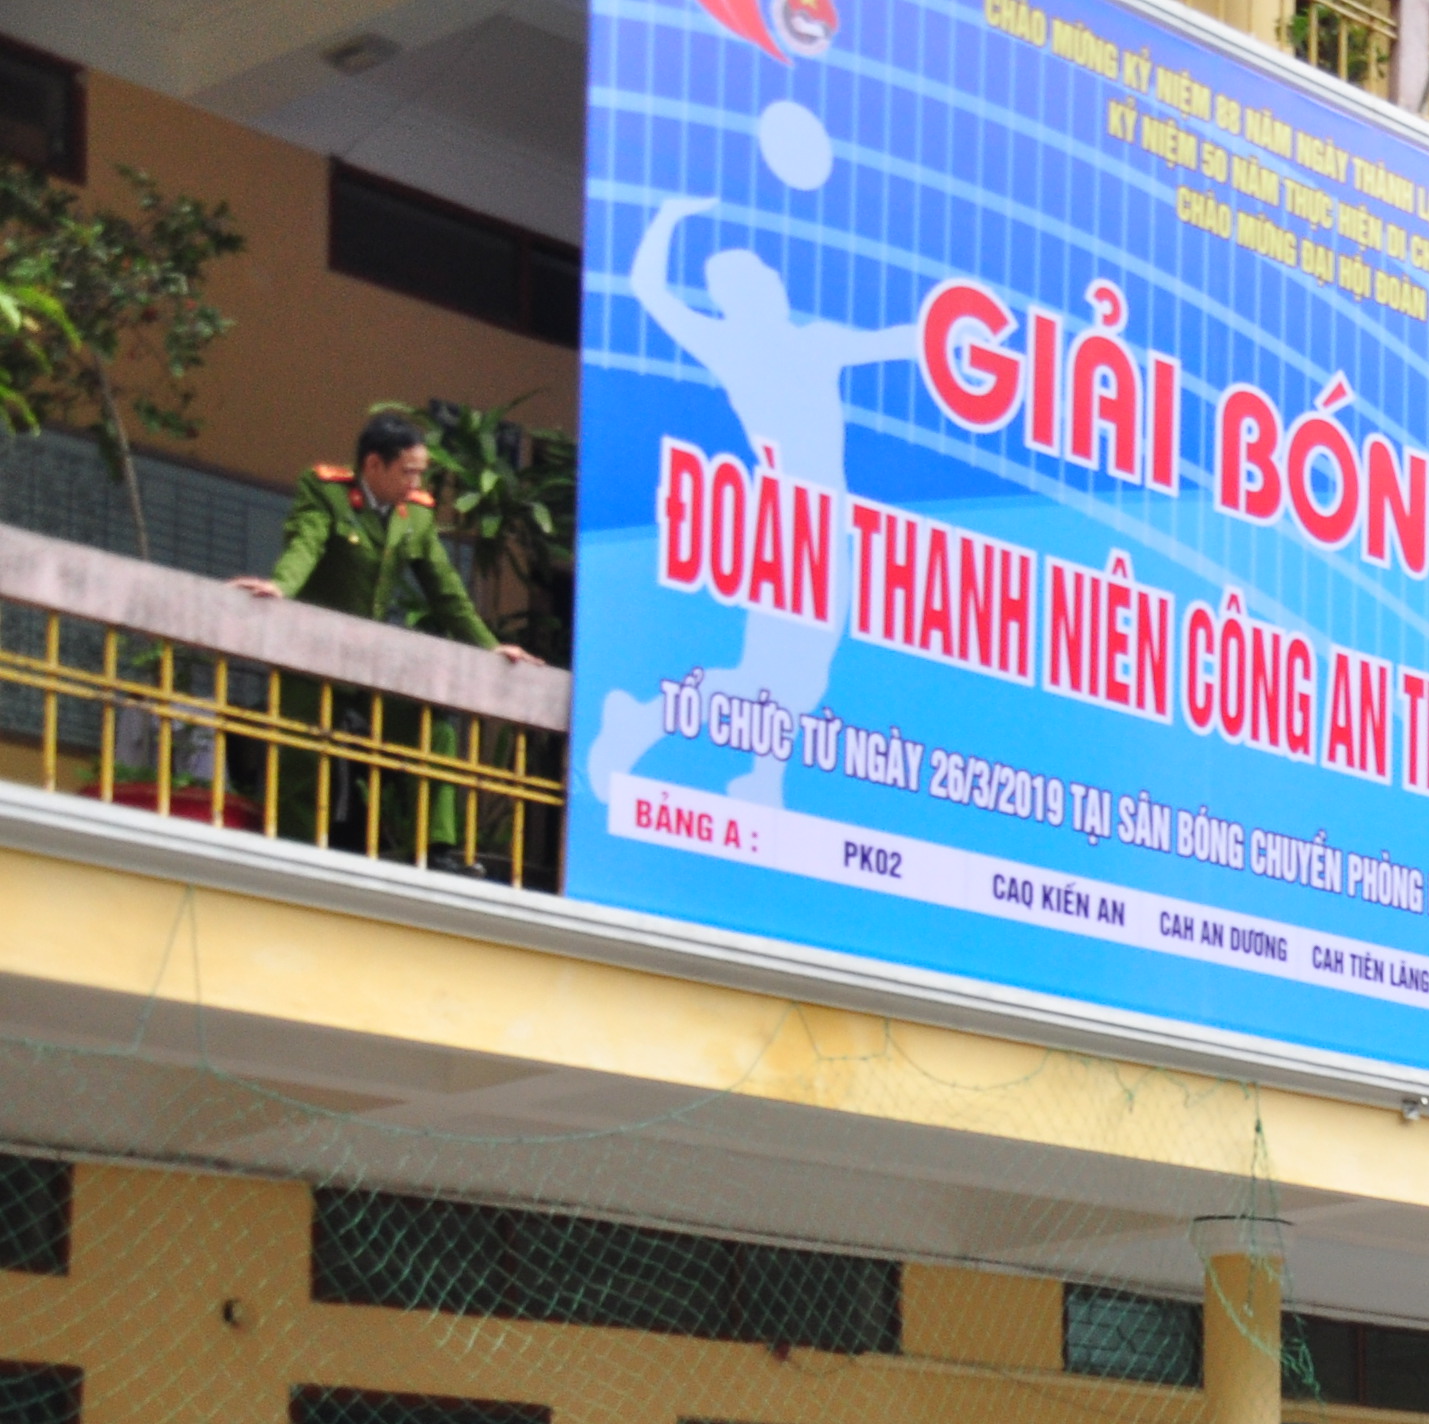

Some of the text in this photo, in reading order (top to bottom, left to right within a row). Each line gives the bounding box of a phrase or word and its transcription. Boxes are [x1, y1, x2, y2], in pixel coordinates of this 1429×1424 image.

[919, 280, 1179, 496] GIẢI
[662, 438, 833, 628] ĐOÀN
[849, 498, 1034, 685] THANH
[1045, 551, 1174, 724] NIÊN
[1182, 588, 1315, 763] CÔNG
[1326, 649, 1391, 784] AN
[661, 667, 704, 738] TỔ
[709, 689, 793, 760] CHỨC
[800, 707, 842, 772] TỪ
[844, 725, 924, 792] NGÀY
[930, 750, 1064, 827] 26/3/2019
[1070, 783, 1112, 846] TẠI
[1117, 790, 1172, 852] SÂN
[1177, 805, 1244, 870] BÓNG
[1348, 849, 1424, 914] PHÒNG
[635, 790, 741, 849] BẢNG A
[843, 840, 903, 879] PK02
[993, 873, 1126, 927] CAQ KIẾN AN
[1160, 911, 1288, 962] CAH AN DƯƠNG
[1312, 945, 1344, 974] CAH
[1350, 951, 1384, 983] TIÊN
